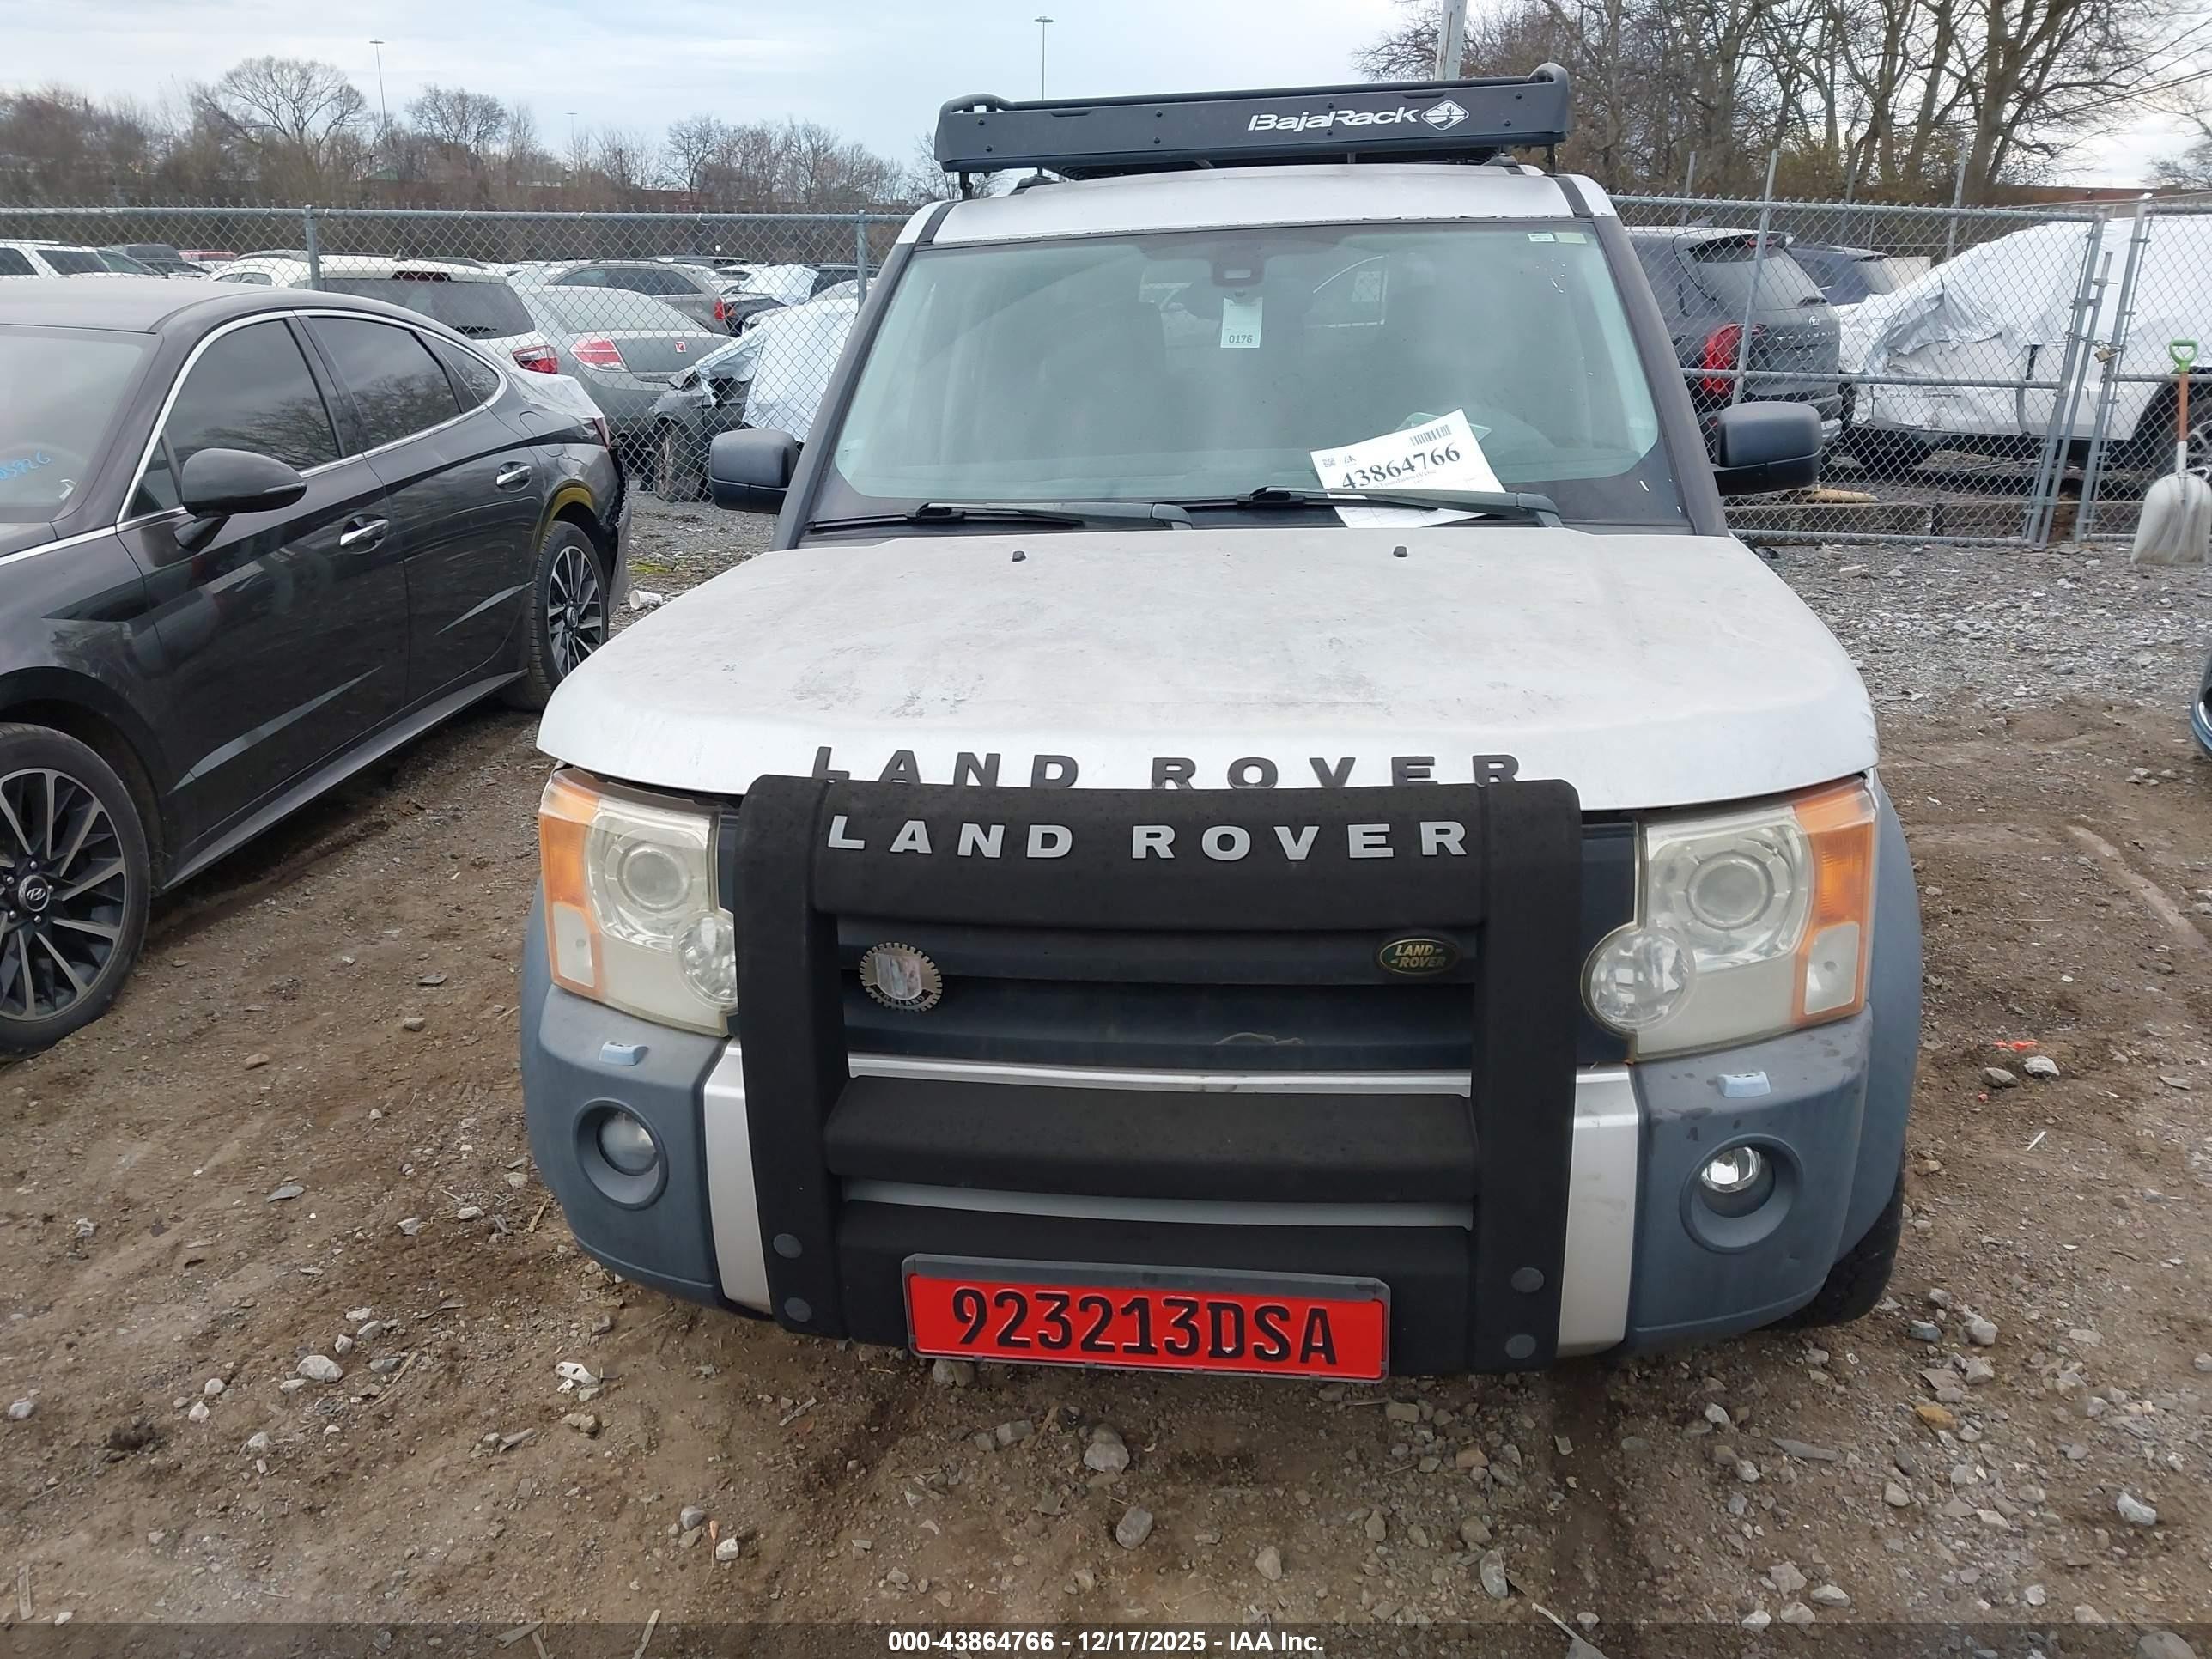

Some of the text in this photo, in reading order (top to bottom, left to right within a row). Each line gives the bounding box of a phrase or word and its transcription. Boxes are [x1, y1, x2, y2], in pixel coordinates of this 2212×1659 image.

[1247, 106, 1420, 132] BajaRack
[1229, 334, 1253, 344] 0176
[1341, 442, 1461, 489] 43864766
[812, 746, 1519, 790] LAND ROVER
[827, 815, 1468, 861] LAND ROVER
[952, 1287, 1338, 1366] 923213DSA
